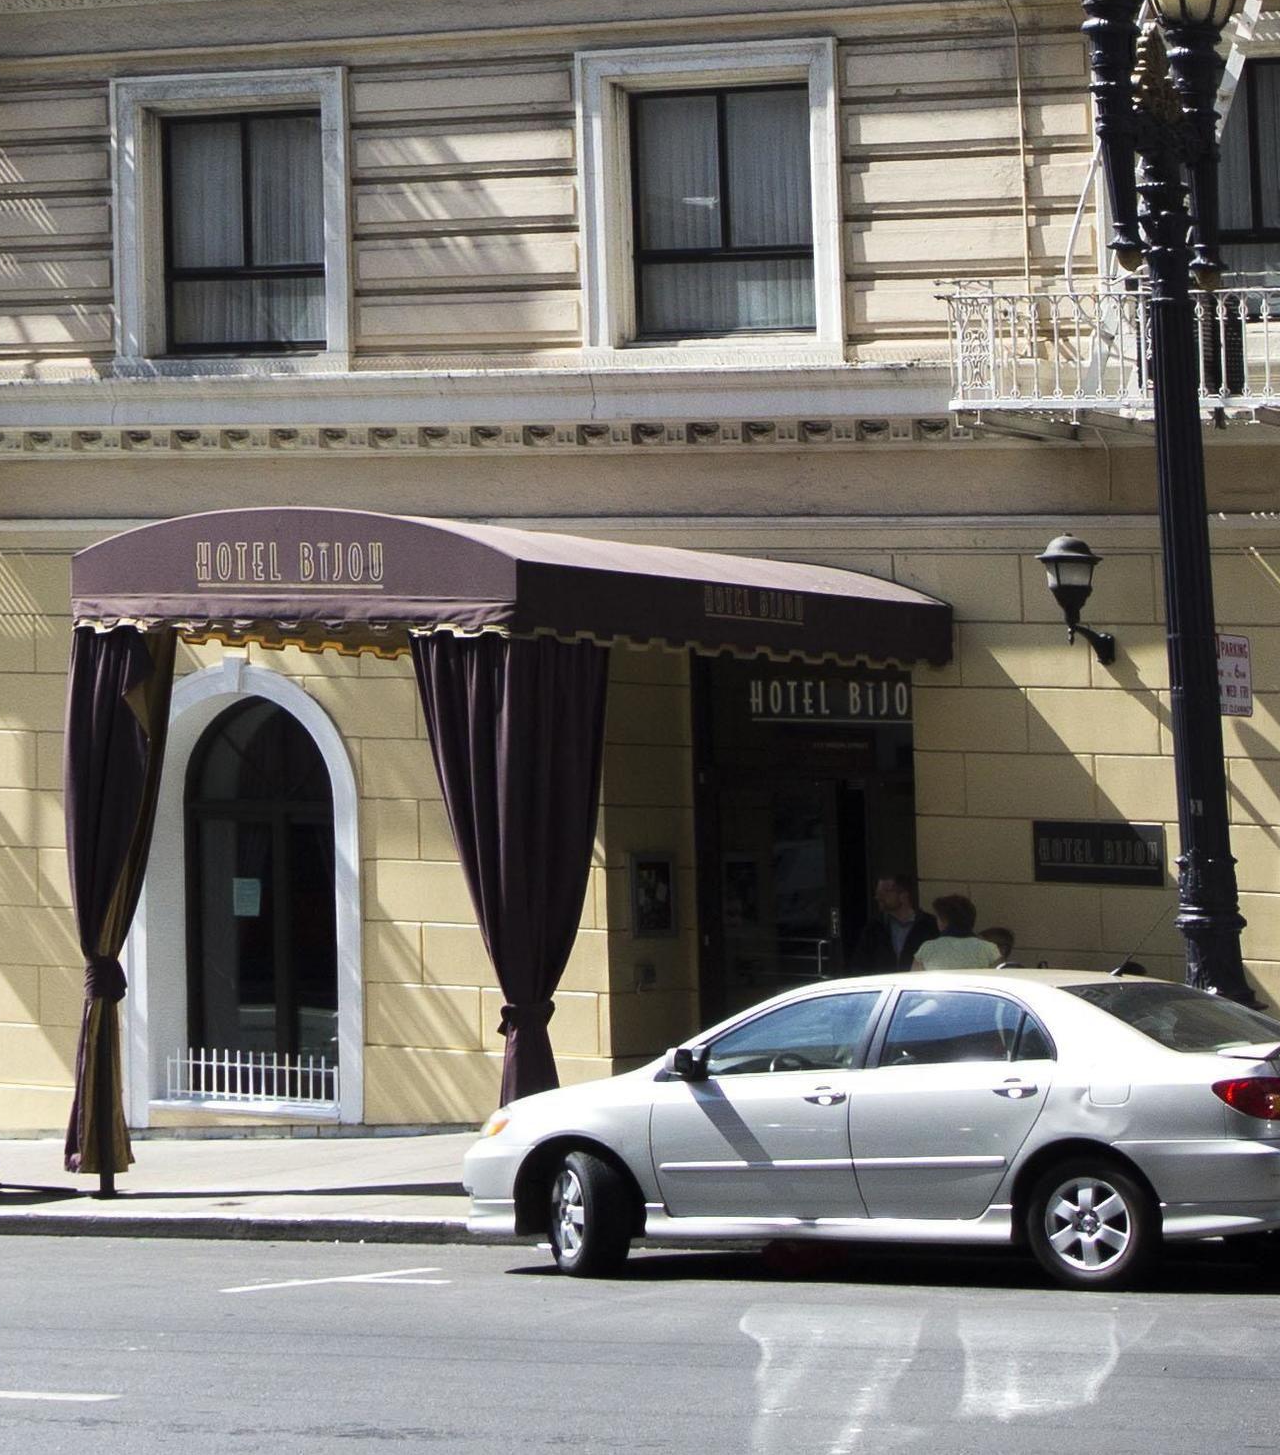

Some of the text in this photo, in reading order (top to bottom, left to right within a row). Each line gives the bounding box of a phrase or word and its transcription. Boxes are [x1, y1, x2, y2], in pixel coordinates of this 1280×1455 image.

[196, 542, 384, 582] HOTEL BIJOU
[704, 585, 805, 621] HOTEL BIJOU
[1220, 642, 1248, 658] PARKING
[750, 680, 830, 714] HOTEL
[1039, 838, 1158, 865] HOTEL BIJOU
